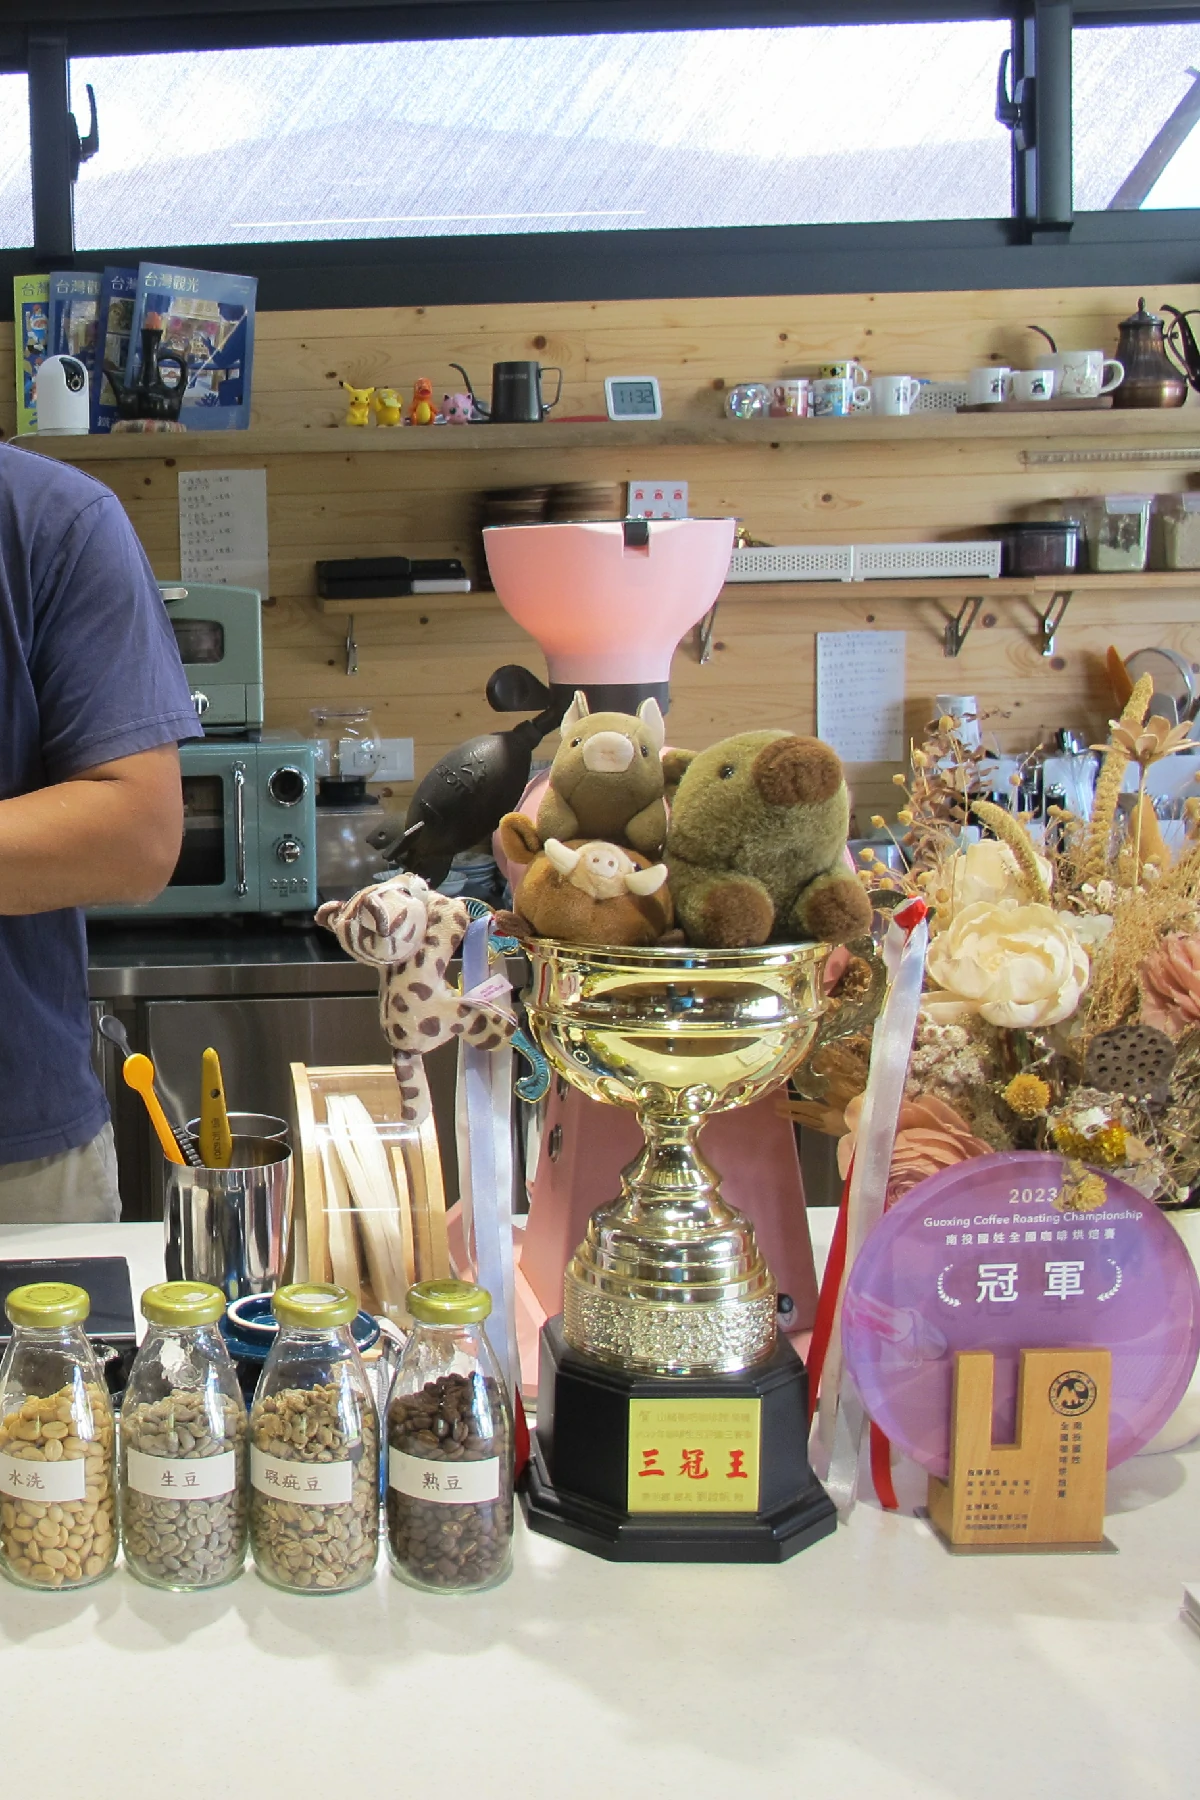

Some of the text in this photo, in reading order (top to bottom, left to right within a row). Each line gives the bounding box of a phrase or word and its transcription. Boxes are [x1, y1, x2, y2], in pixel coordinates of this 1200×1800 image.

[144, 271, 199, 293] 台灣觀光
[1008, 1187, 1058, 1204] 2023
[923, 1210, 1143, 1229] Guoxing Coffee Roasting Championship
[975, 1260, 1085, 1303] 冠軍
[637, 1448, 749, 1479] 三冠王
[8, 1469, 46, 1490] 水洗
[160, 1470, 201, 1487] 生豆
[264, 1468, 323, 1492] 瑕疵豆
[422, 1471, 463, 1491] 熟豆
